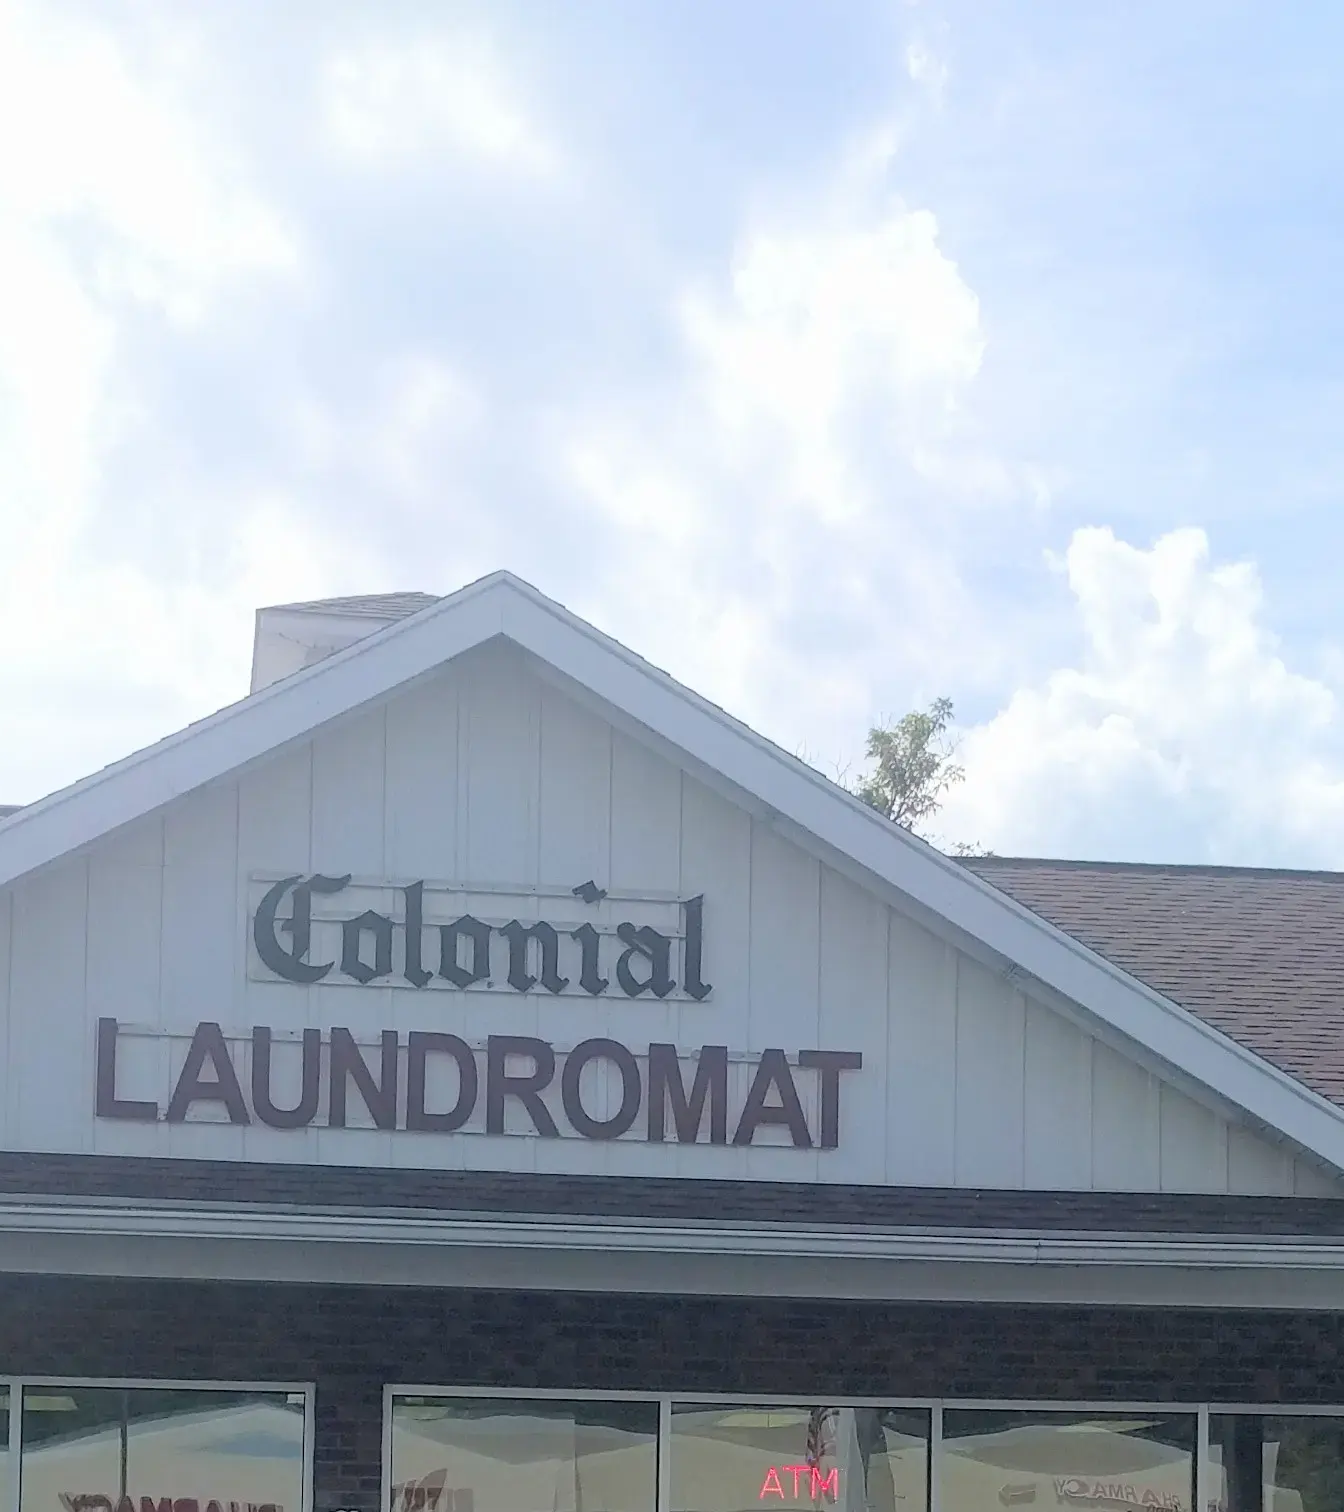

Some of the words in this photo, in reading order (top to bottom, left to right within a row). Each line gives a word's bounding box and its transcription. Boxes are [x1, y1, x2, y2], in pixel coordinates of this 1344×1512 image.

[253, 872, 713, 1001] Colonial
[95, 1016, 863, 1149] LAUNDROMAT
[759, 1465, 839, 1502] ATM
